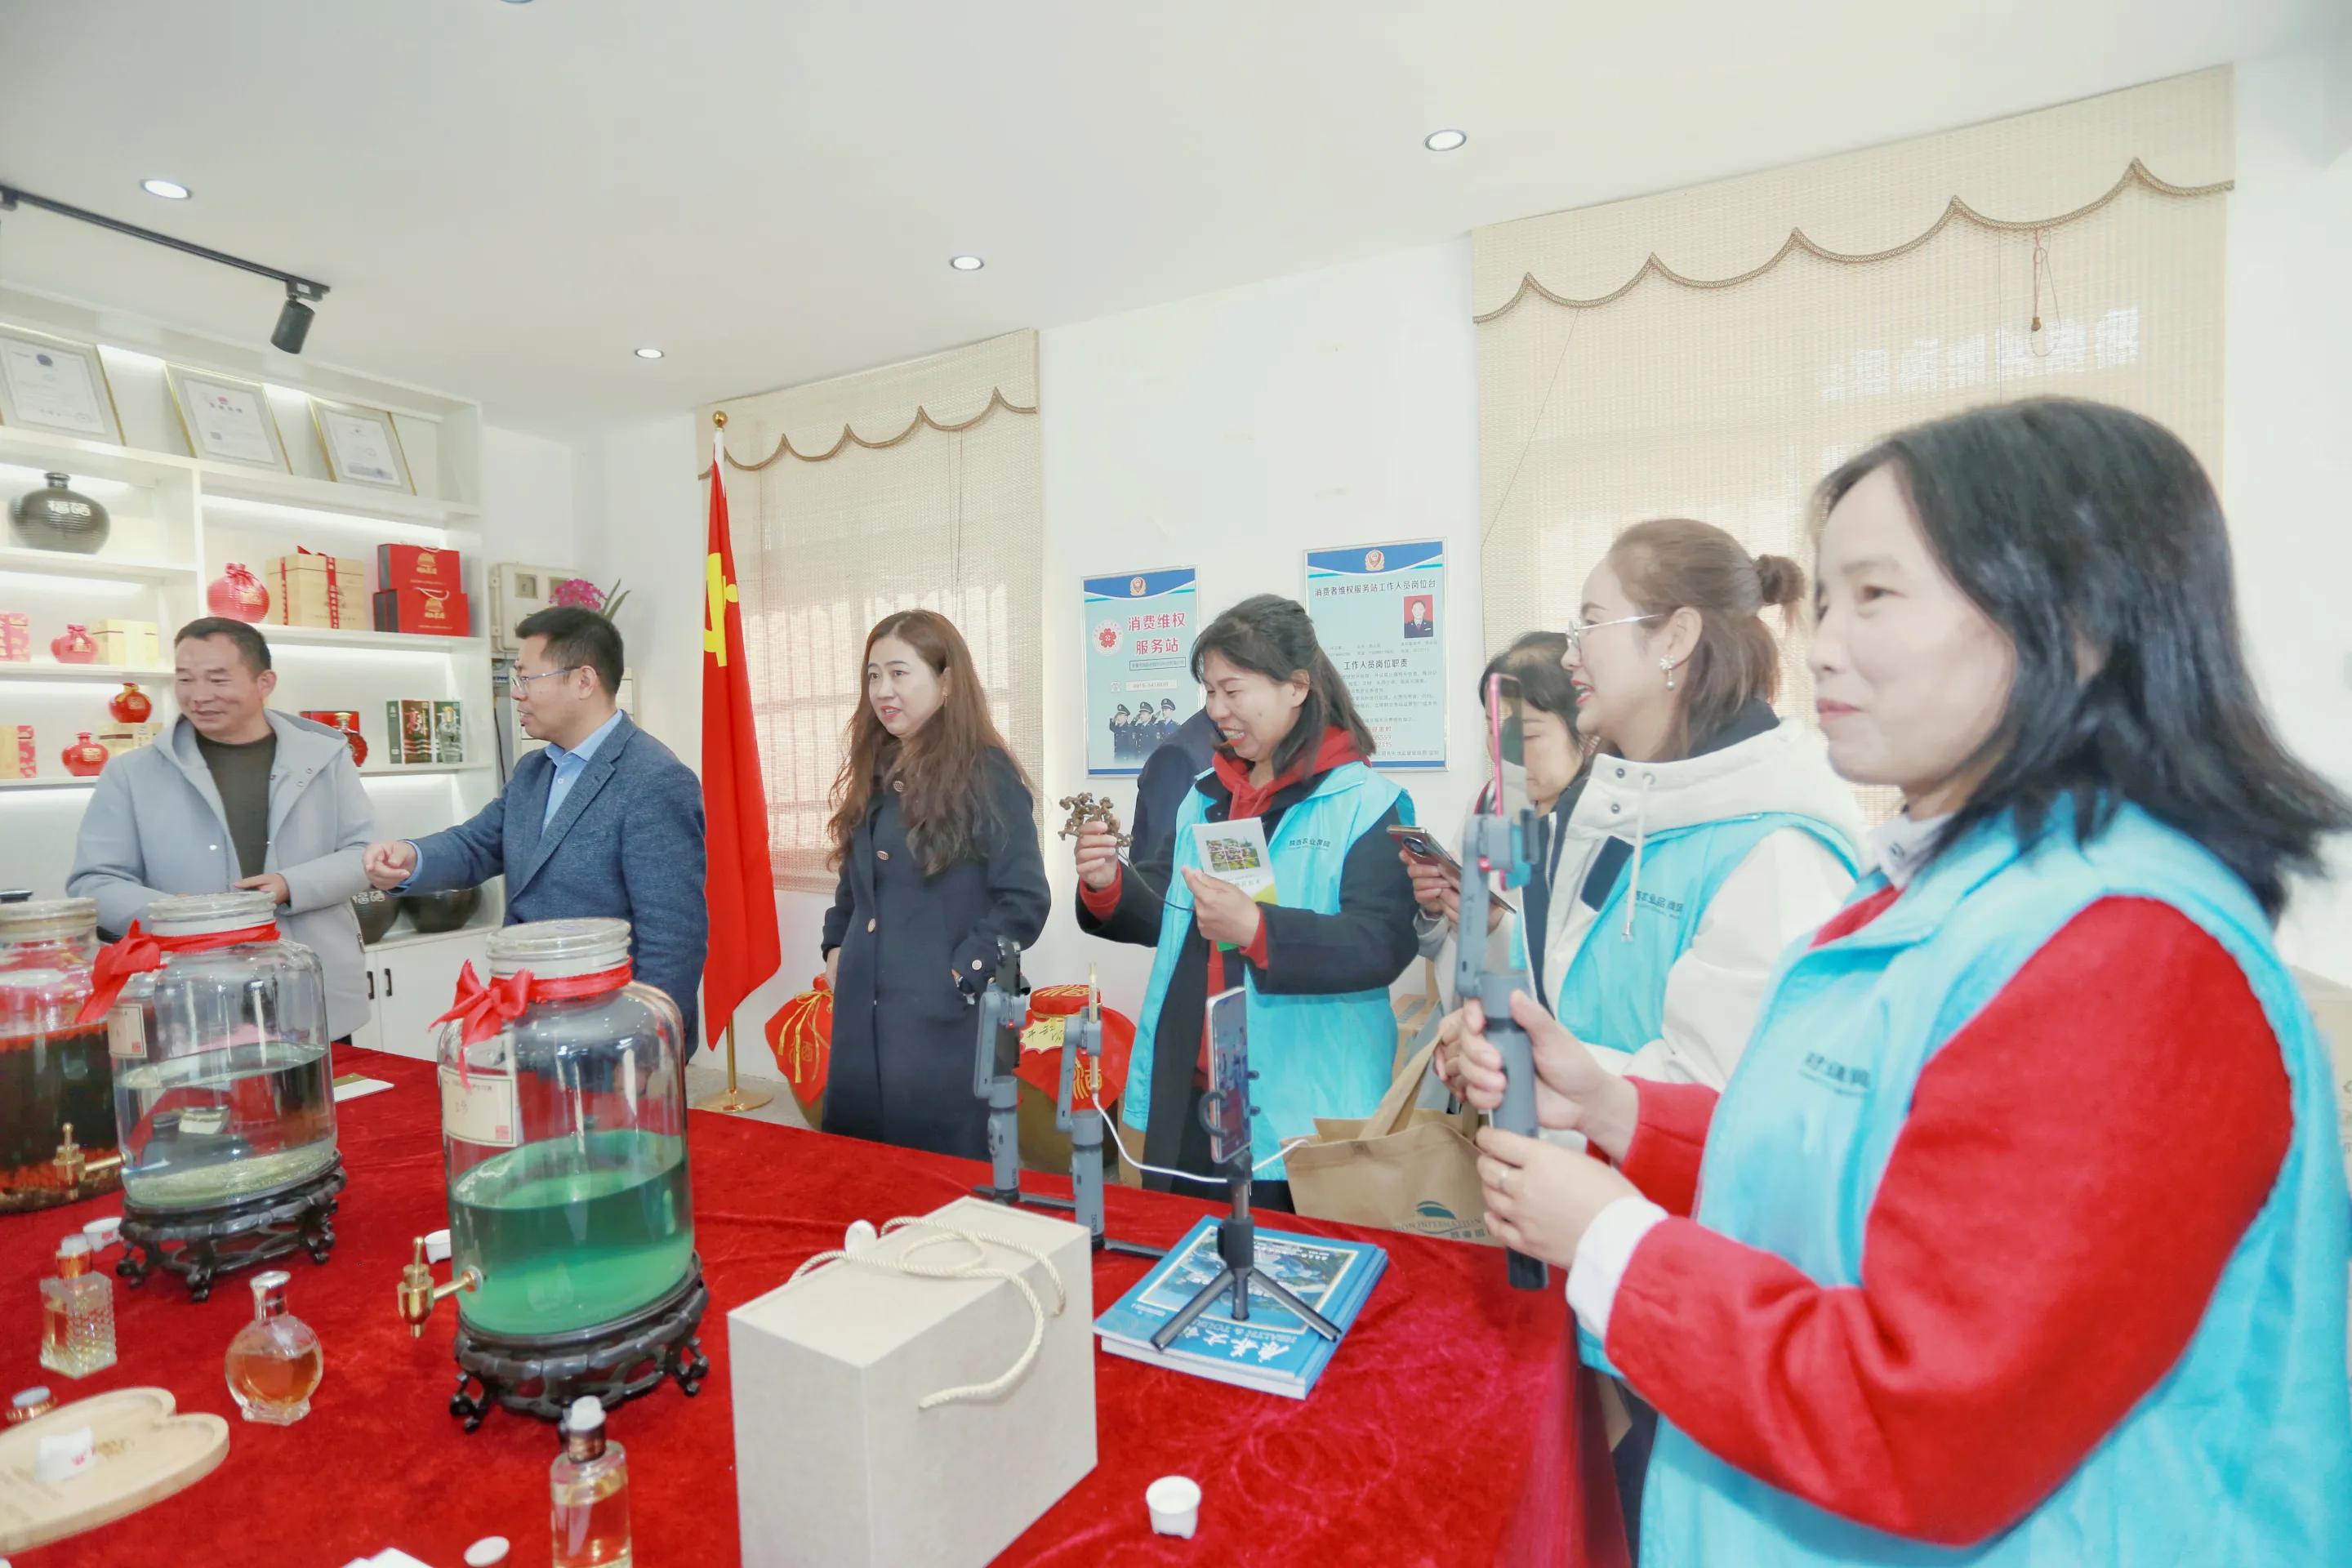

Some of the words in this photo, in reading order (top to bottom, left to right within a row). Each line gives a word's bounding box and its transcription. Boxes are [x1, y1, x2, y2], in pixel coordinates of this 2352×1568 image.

[1128, 612, 1186, 631] 消费维权
[1136, 638, 1178, 655] 服务站
[1343, 658, 1408, 670] 工作人员岗位职责
